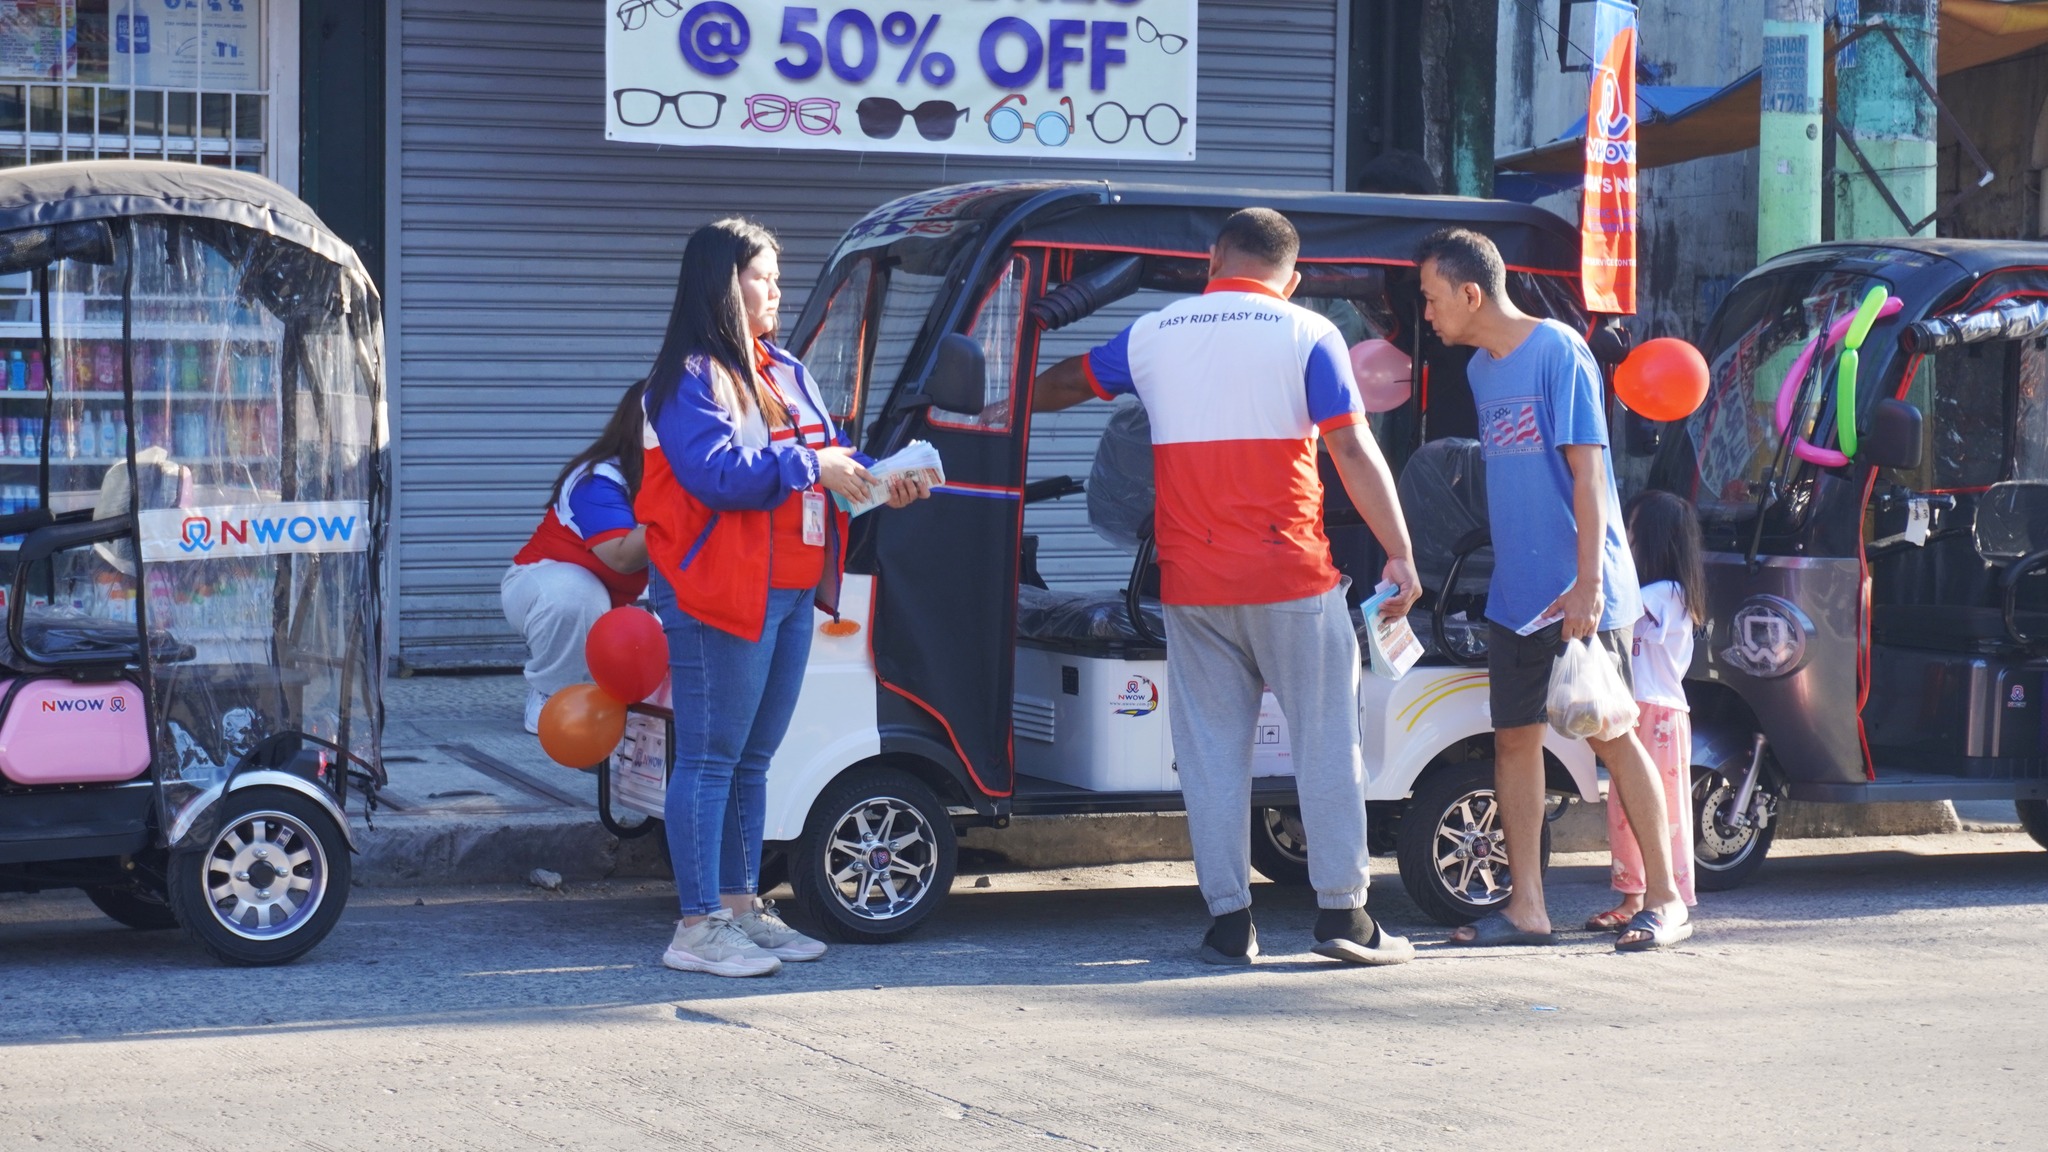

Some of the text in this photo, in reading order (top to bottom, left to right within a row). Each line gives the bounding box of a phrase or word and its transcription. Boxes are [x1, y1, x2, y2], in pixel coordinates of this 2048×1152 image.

[678, 0, 1128, 91] @ 50% OFF
[1159, 311, 1283, 329] EASY RIDE EASY BUY
[221, 516, 356, 545] NWOW
[42, 699, 104, 712] NWOW
